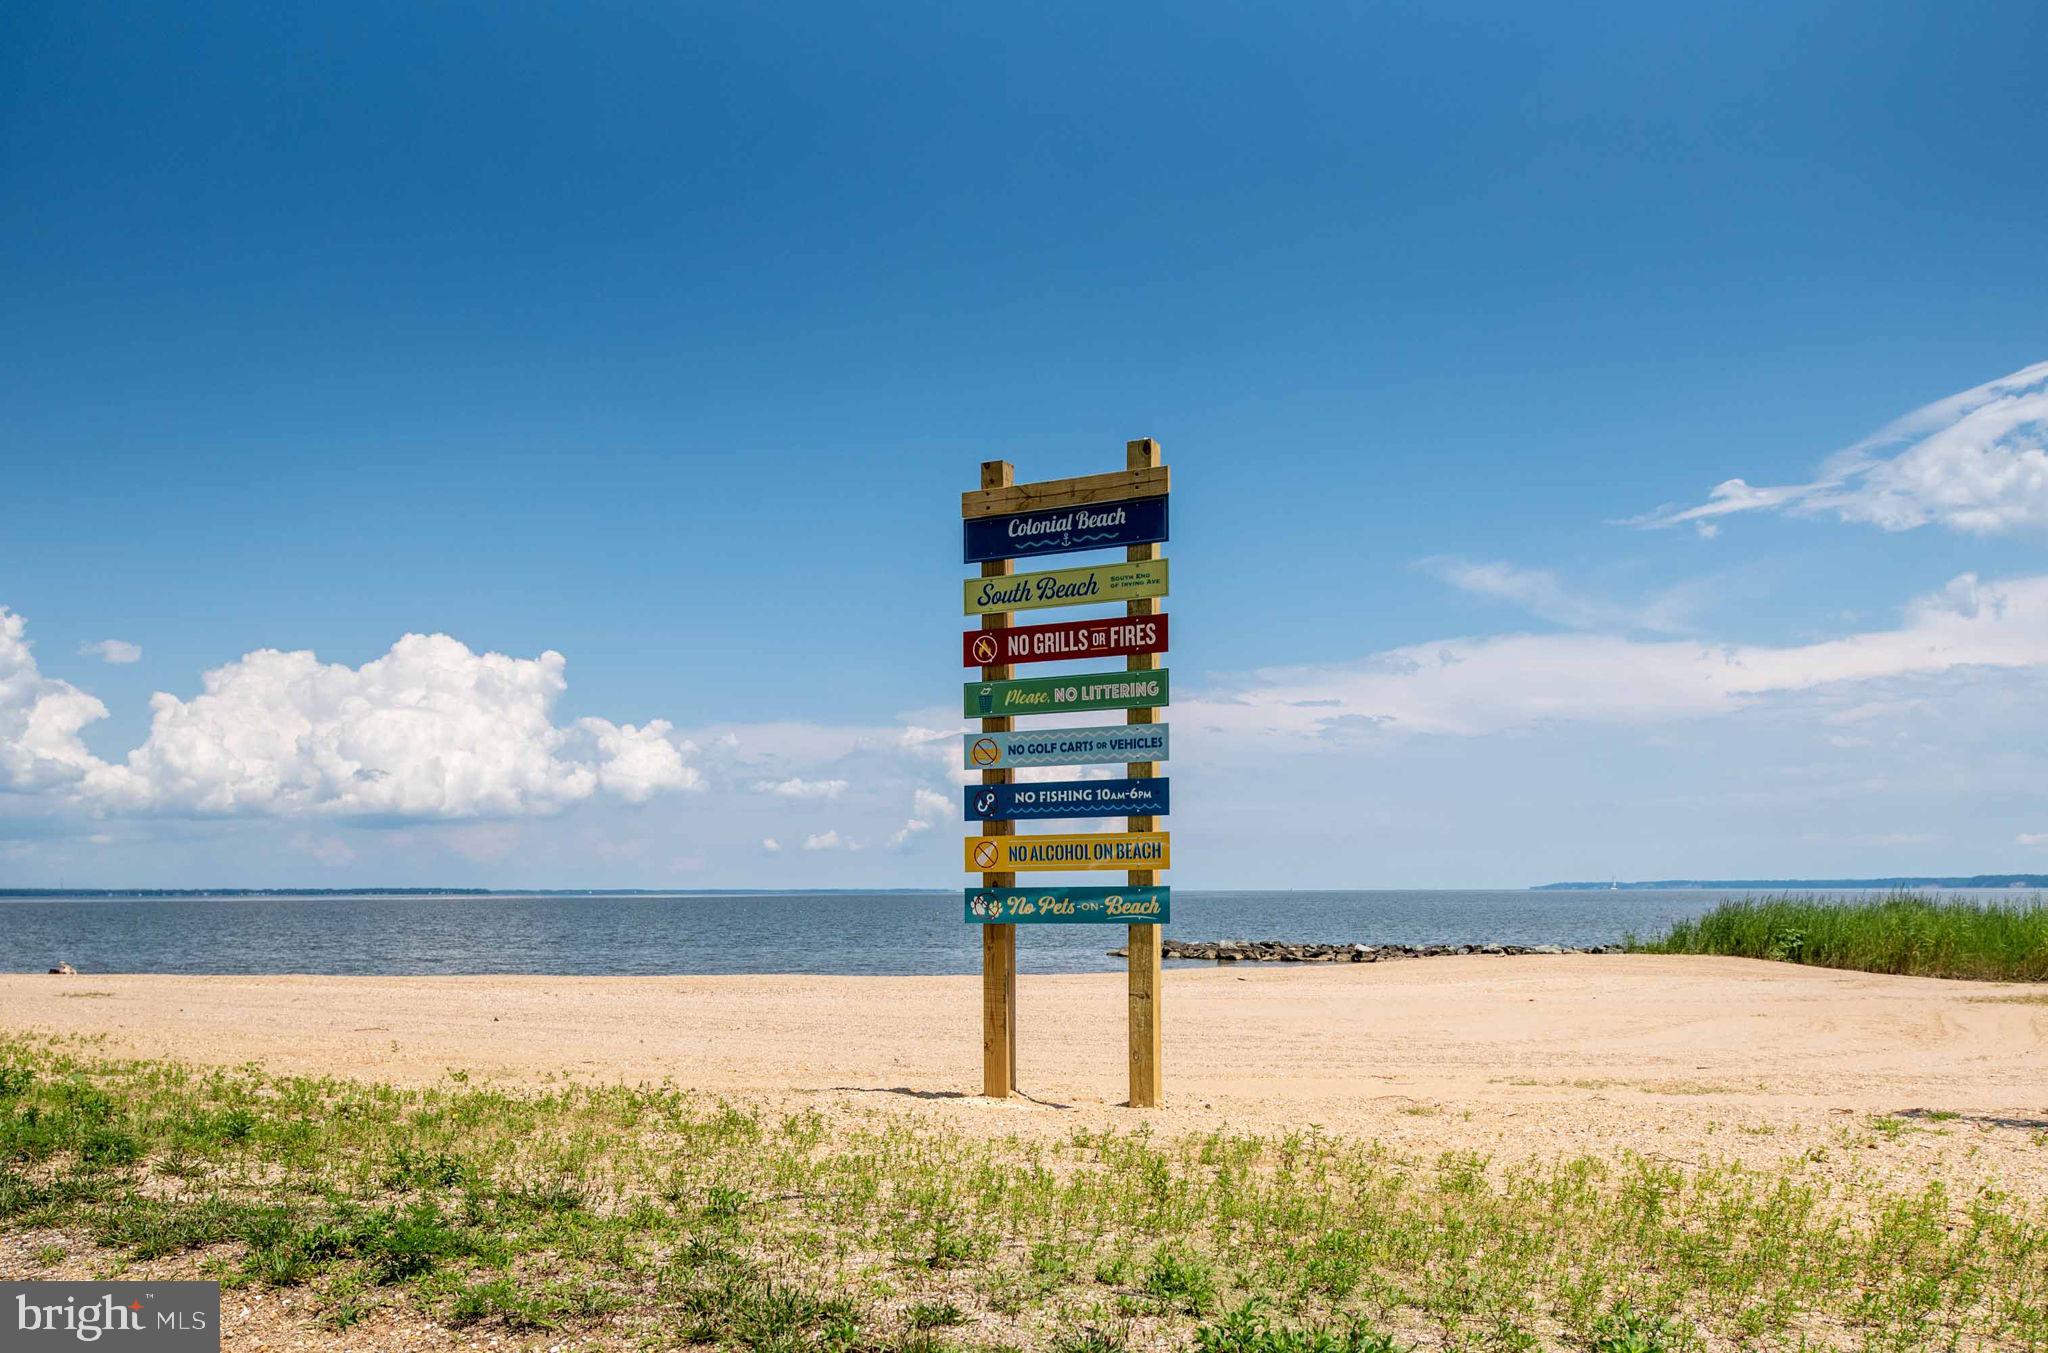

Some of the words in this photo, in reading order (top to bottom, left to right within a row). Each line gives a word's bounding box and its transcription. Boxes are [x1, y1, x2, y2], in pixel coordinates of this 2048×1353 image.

[1008, 514, 1073, 537] Colonial
[1075, 507, 1127, 529] Beach
[977, 579, 1033, 606] South
[1036, 573, 1099, 600] Beach
[1008, 634, 1029, 656] NO
[1033, 629, 1088, 654] GRILLS
[1092, 632, 1106, 646] OR
[1110, 623, 1156, 647] FIRES
[1054, 687, 1078, 702] NO
[1081, 681, 1160, 701] LITTERING
[1008, 744, 1024, 756] NO
[1027, 742, 1057, 754] GOLF
[1059, 740, 1094, 753] CARTS
[1096, 741, 1107, 749] OR
[1109, 736, 1163, 750] VEHICLES
[1015, 791, 1036, 803] NO
[1039, 789, 1092, 802] FISHING
[1097, 788, 1152, 800] 10AM-6PM
[1009, 845, 1027, 862] NO
[1030, 843, 1091, 861] ALCOHOL
[1094, 842, 1113, 859] ON
[1116, 842, 1162, 859] BEACH
[1007, 896, 1036, 915] No
[1038, 896, 1075, 915] Pets
[1104, 895, 1161, 915] Beach
